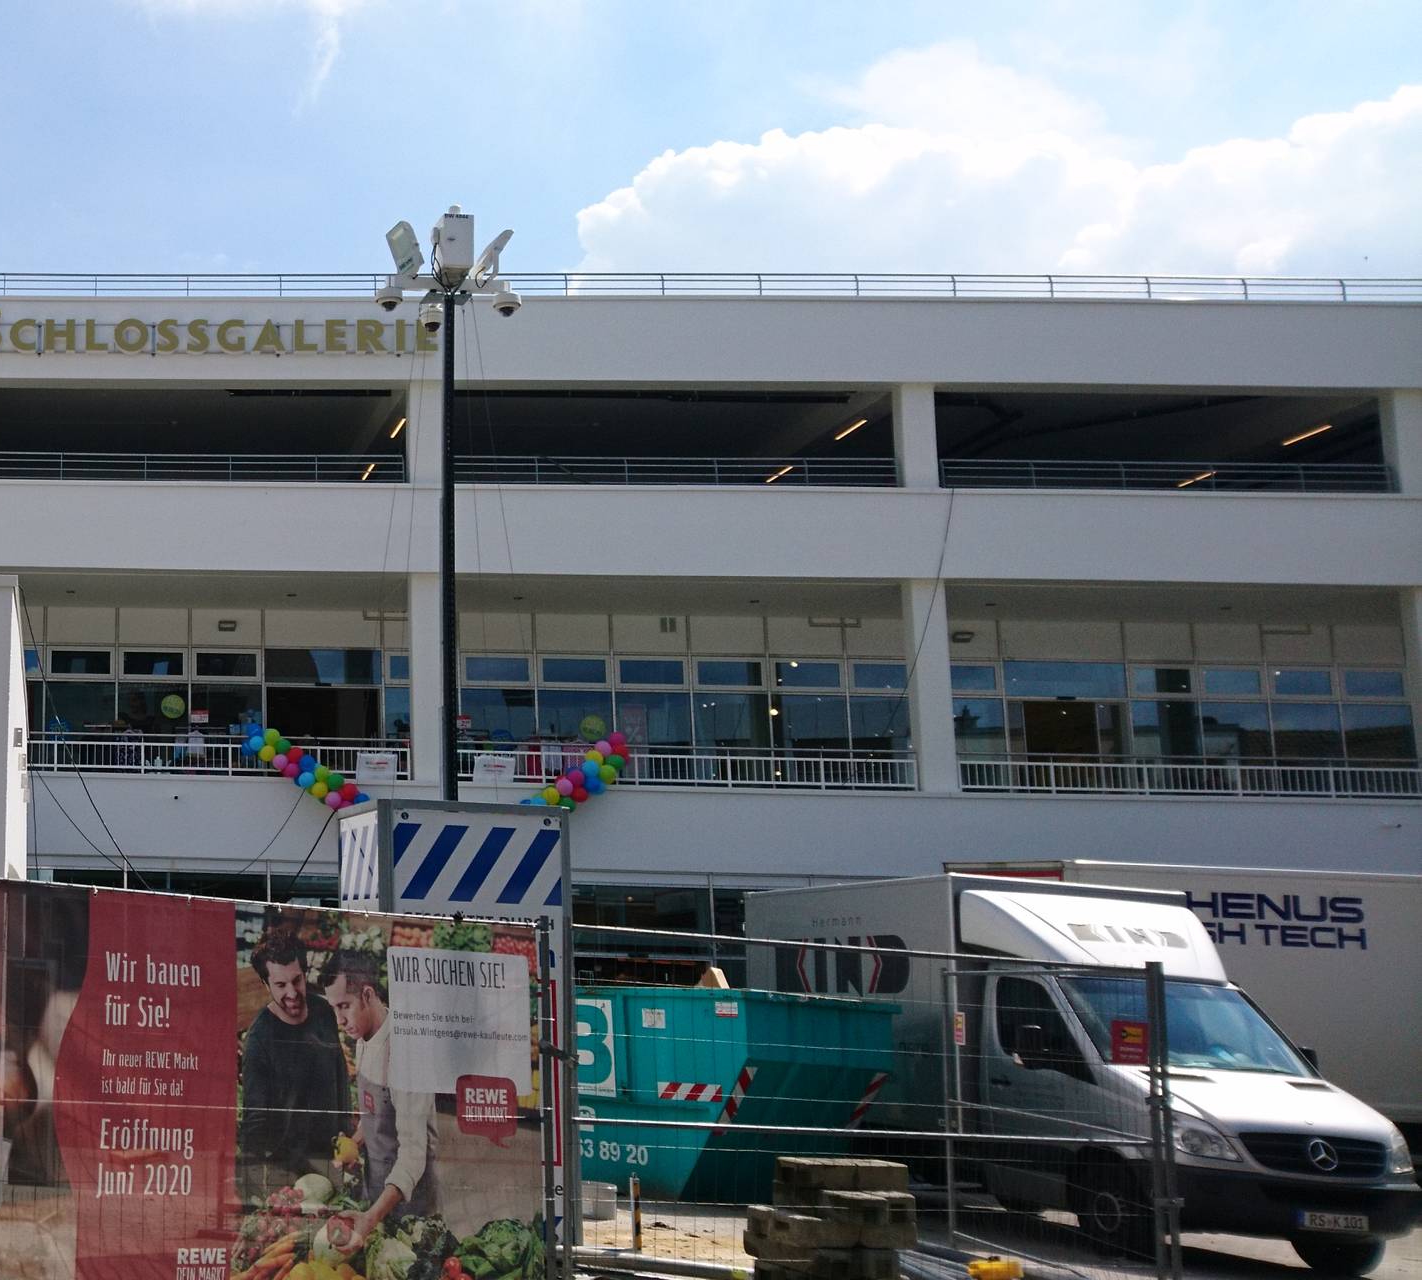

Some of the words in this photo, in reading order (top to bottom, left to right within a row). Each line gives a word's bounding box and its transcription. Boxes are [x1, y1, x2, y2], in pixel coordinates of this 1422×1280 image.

[811, 915, 863, 928] Hermann
[1255, 924, 1367, 950] TECH
[105, 951, 137, 983] Wir
[146, 953, 201, 987] bauen
[391, 955, 421, 983] WIR
[425, 957, 475, 987] SUCHEN
[480, 962, 506, 989] SIE!
[105, 994, 130, 1026] für
[137, 996, 170, 1028] Sie!
[393, 1010, 430, 1021] Bewerben
[432, 1012, 443, 1022] Sie
[445, 1013, 459, 1023] sich
[102, 1048, 116, 1067] Ihr
[118, 1053, 142, 1068] neuer
[145, 1050, 171, 1069] REWE
[173, 1052, 199, 1071] Markt
[101, 1076, 113, 1094] ist
[116, 1077, 136, 1095] bald
[139, 1077, 151, 1095] für
[154, 1078, 167, 1096] Sie
[170, 1079, 184, 1097] da!
[465, 1087, 508, 1105] REWE
[465, 1105, 483, 1122] DEIN
[484, 1106, 508, 1123] MARKT
[100, 1118, 194, 1160] Eröffnung
[599, 1140, 620, 1162] 89
[626, 1144, 649, 1166] 20
[96, 1162, 135, 1198] Juni
[144, 1164, 192, 1196] 2020
[177, 1247, 227, 1265] REWE
